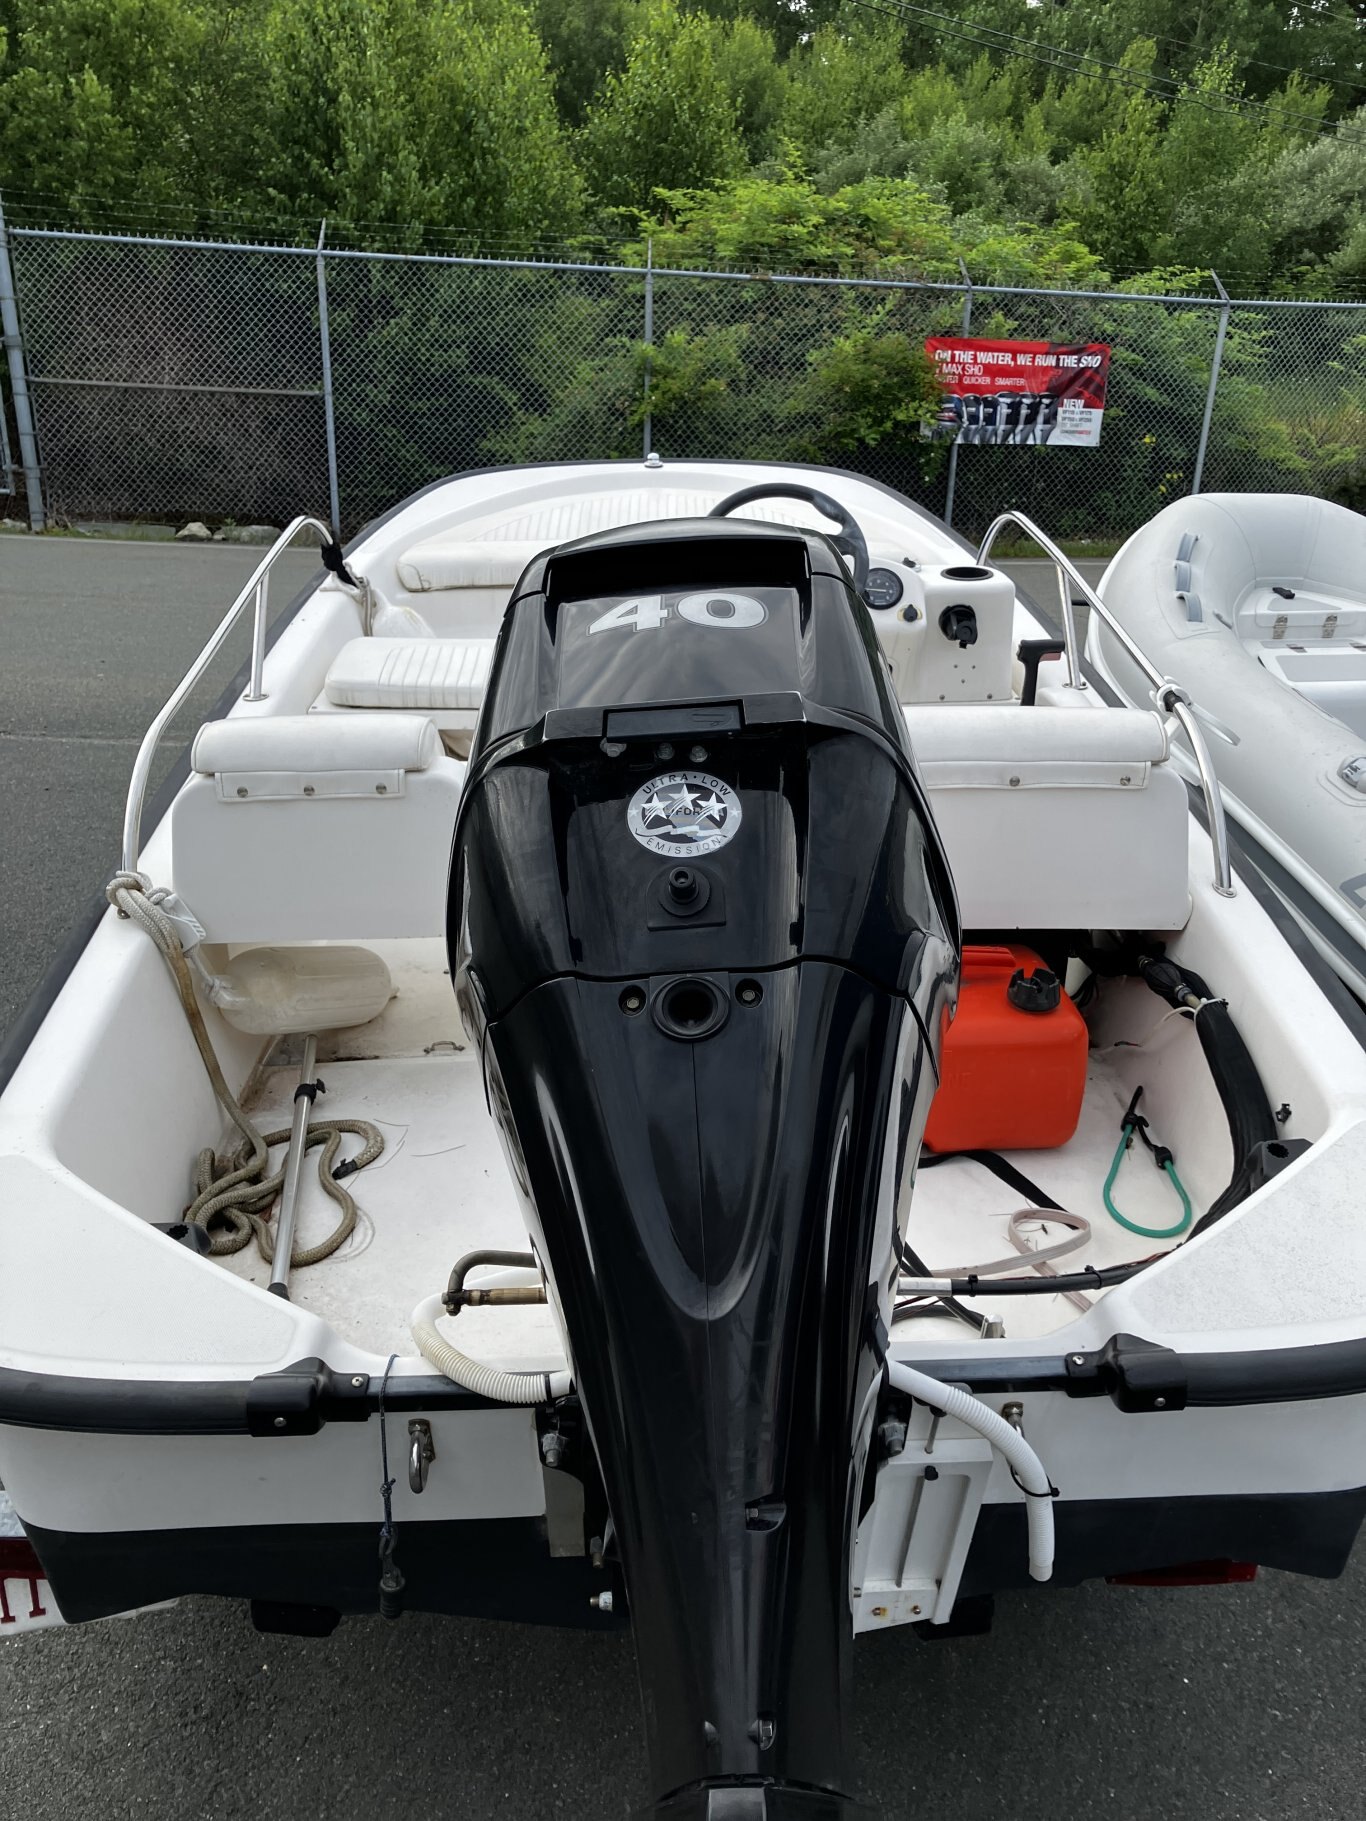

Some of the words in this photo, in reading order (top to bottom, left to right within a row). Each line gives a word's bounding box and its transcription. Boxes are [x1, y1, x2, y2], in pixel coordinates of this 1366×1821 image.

[935, 350, 951, 362] ON
[953, 351, 974, 363] THE
[976, 352, 1014, 367] WATER,
[1017, 354, 1033, 366] WE
[1035, 354, 1057, 366] RUN
[1059, 355, 1078, 367] THE
[942, 364, 963, 375] MAX
[964, 364, 983, 376] SHO
[963, 377, 991, 385] QUICKER
[995, 377, 1025, 386] SMARTER
[1063, 398, 1085, 409] NEW
[587, 592, 767, 635] 40
[642, 773, 688, 795] ULTRA
[701, 775, 732, 796] LOW
[646, 838, 721, 855] EMISSION
